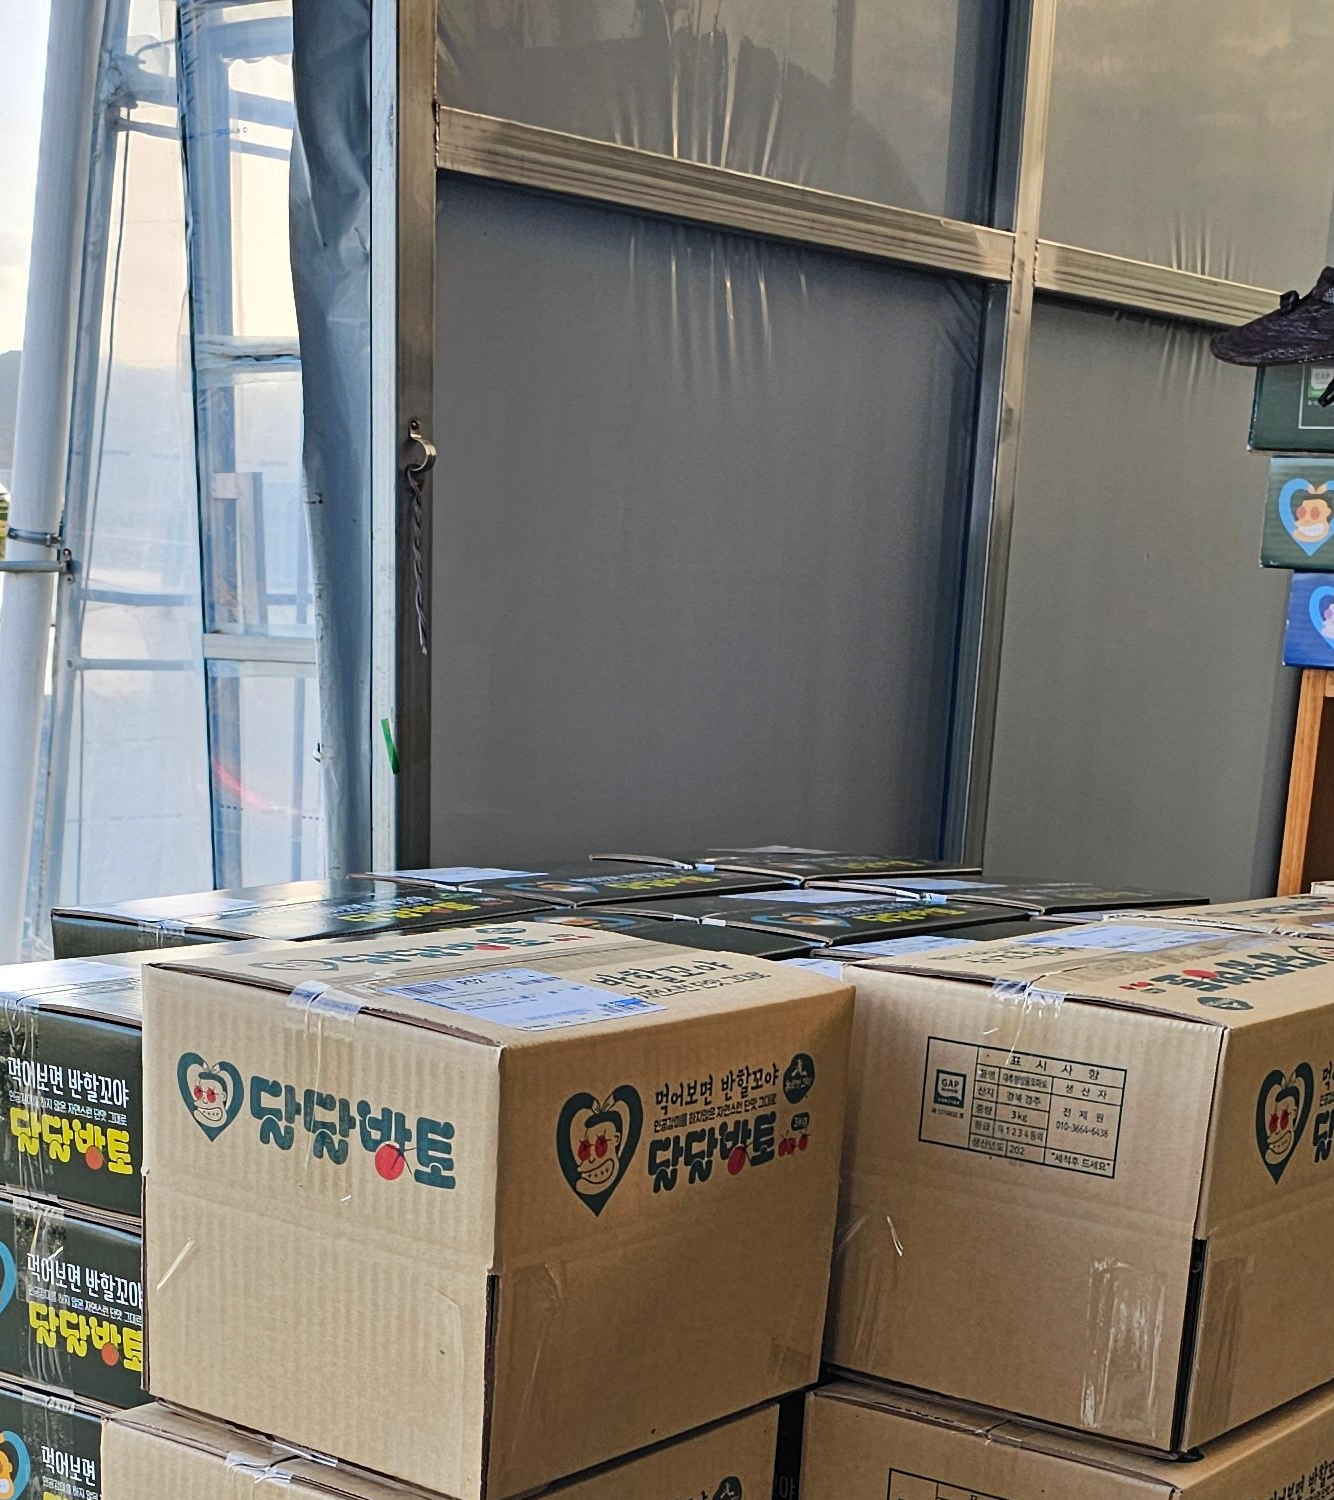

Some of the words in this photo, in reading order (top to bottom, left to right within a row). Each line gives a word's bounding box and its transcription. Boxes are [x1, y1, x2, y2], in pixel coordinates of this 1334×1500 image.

[8, 1057, 63, 1095] 먹어보면
[68, 1068, 129, 1108] 반할꼬야
[655, 1074, 713, 1115] 먹어보면
[721, 1062, 780, 1100] 반할꼬야
[942, 1078, 959, 1088] GAP
[978, 1087, 994, 1097] 산지
[249, 1075, 458, 1191] 달달방토
[1011, 1110, 1027, 1123] 3kg
[1056, 1121, 1108, 1138] 010-3664-6438
[10, 1106, 133, 1175] 달달방토
[648, 1111, 777, 1193] 달달방토
[1009, 1145, 1025, 1155] 202
[27, 1253, 81, 1292] 먹어보면
[41, 1445, 96, 1487] 먹어보면
